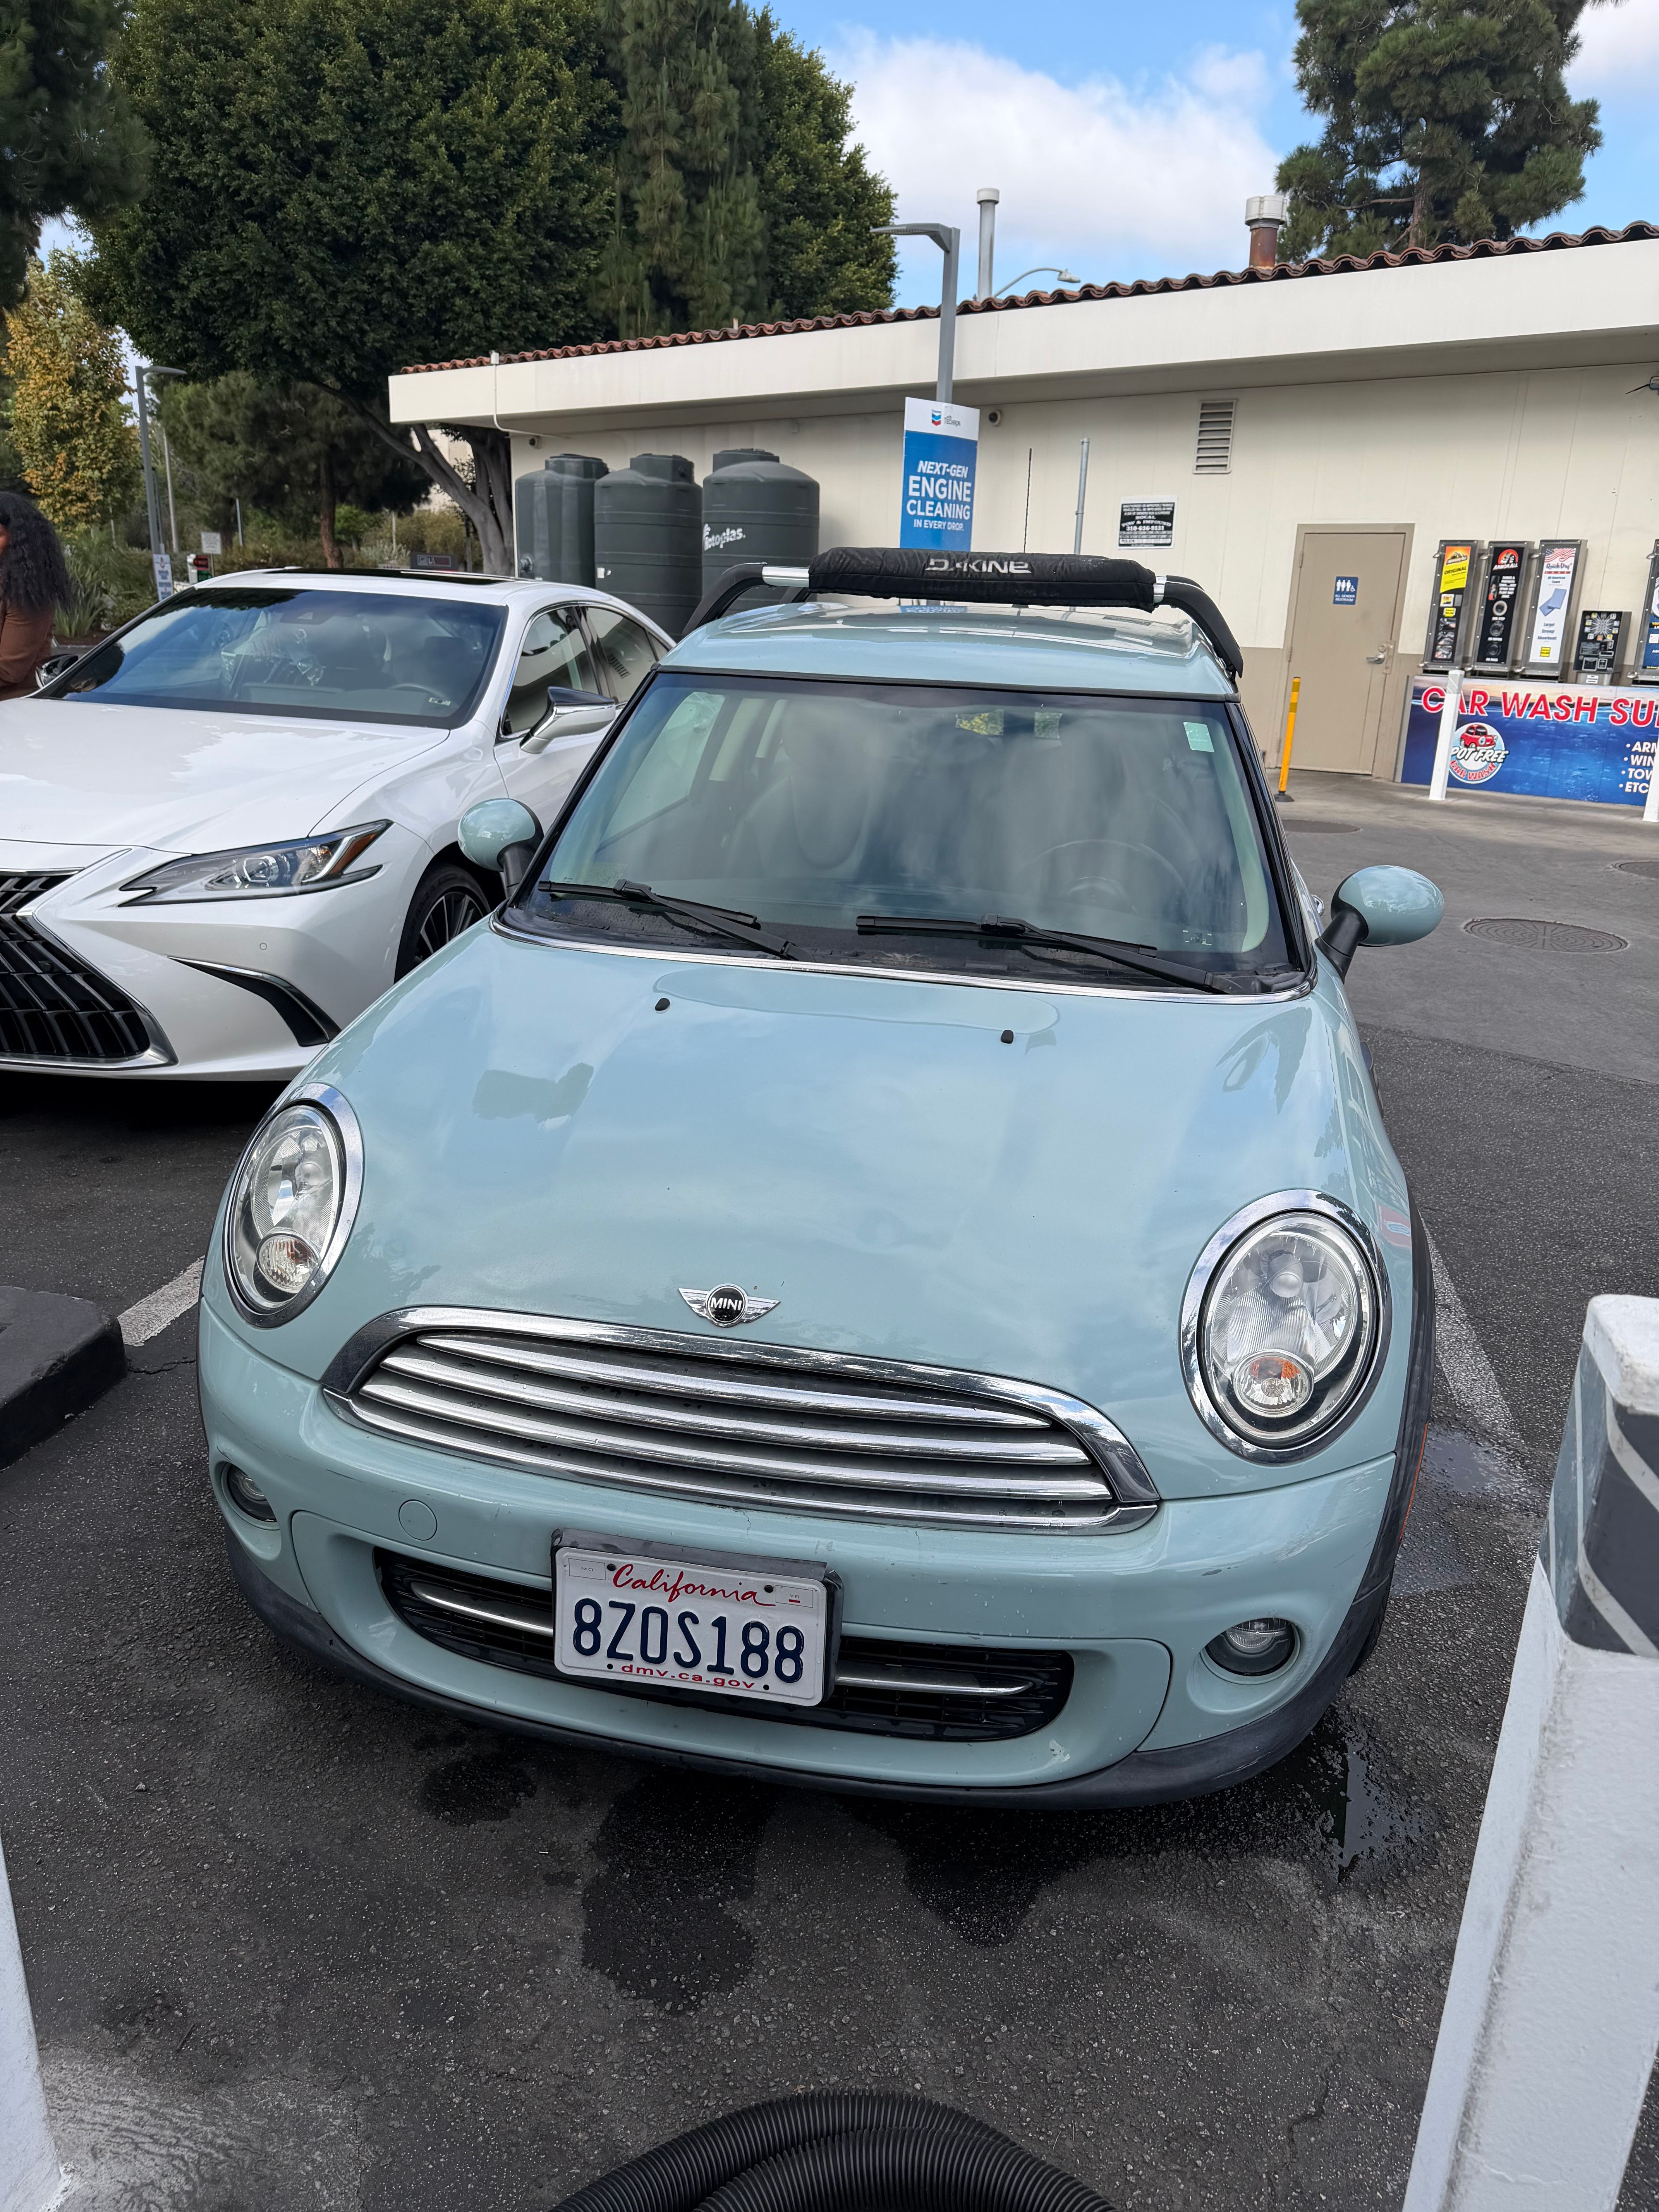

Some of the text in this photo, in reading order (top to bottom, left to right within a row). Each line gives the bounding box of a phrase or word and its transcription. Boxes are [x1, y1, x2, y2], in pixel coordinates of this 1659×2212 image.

[917, 460, 969, 478] NEXT-GEN
[908, 475, 972, 502] ENGINE
[906, 499, 970, 520] CLEANING
[914, 519, 922, 527] IN
[924, 520, 946, 530] EVERY
[1444, 566, 1467, 575] ORIGINAL
[1501, 691, 1600, 724] WASH
[1609, 697, 1659, 728] SU
[1451, 747, 1476, 760] POT
[1450, 759, 1497, 780] CAR WASH
[710, 1297, 742, 1311] MINI
[613, 1563, 776, 1607] California
[572, 1598, 805, 1684] 8ZOS188
[621, 1664, 755, 1689] dmv.ca.gov
